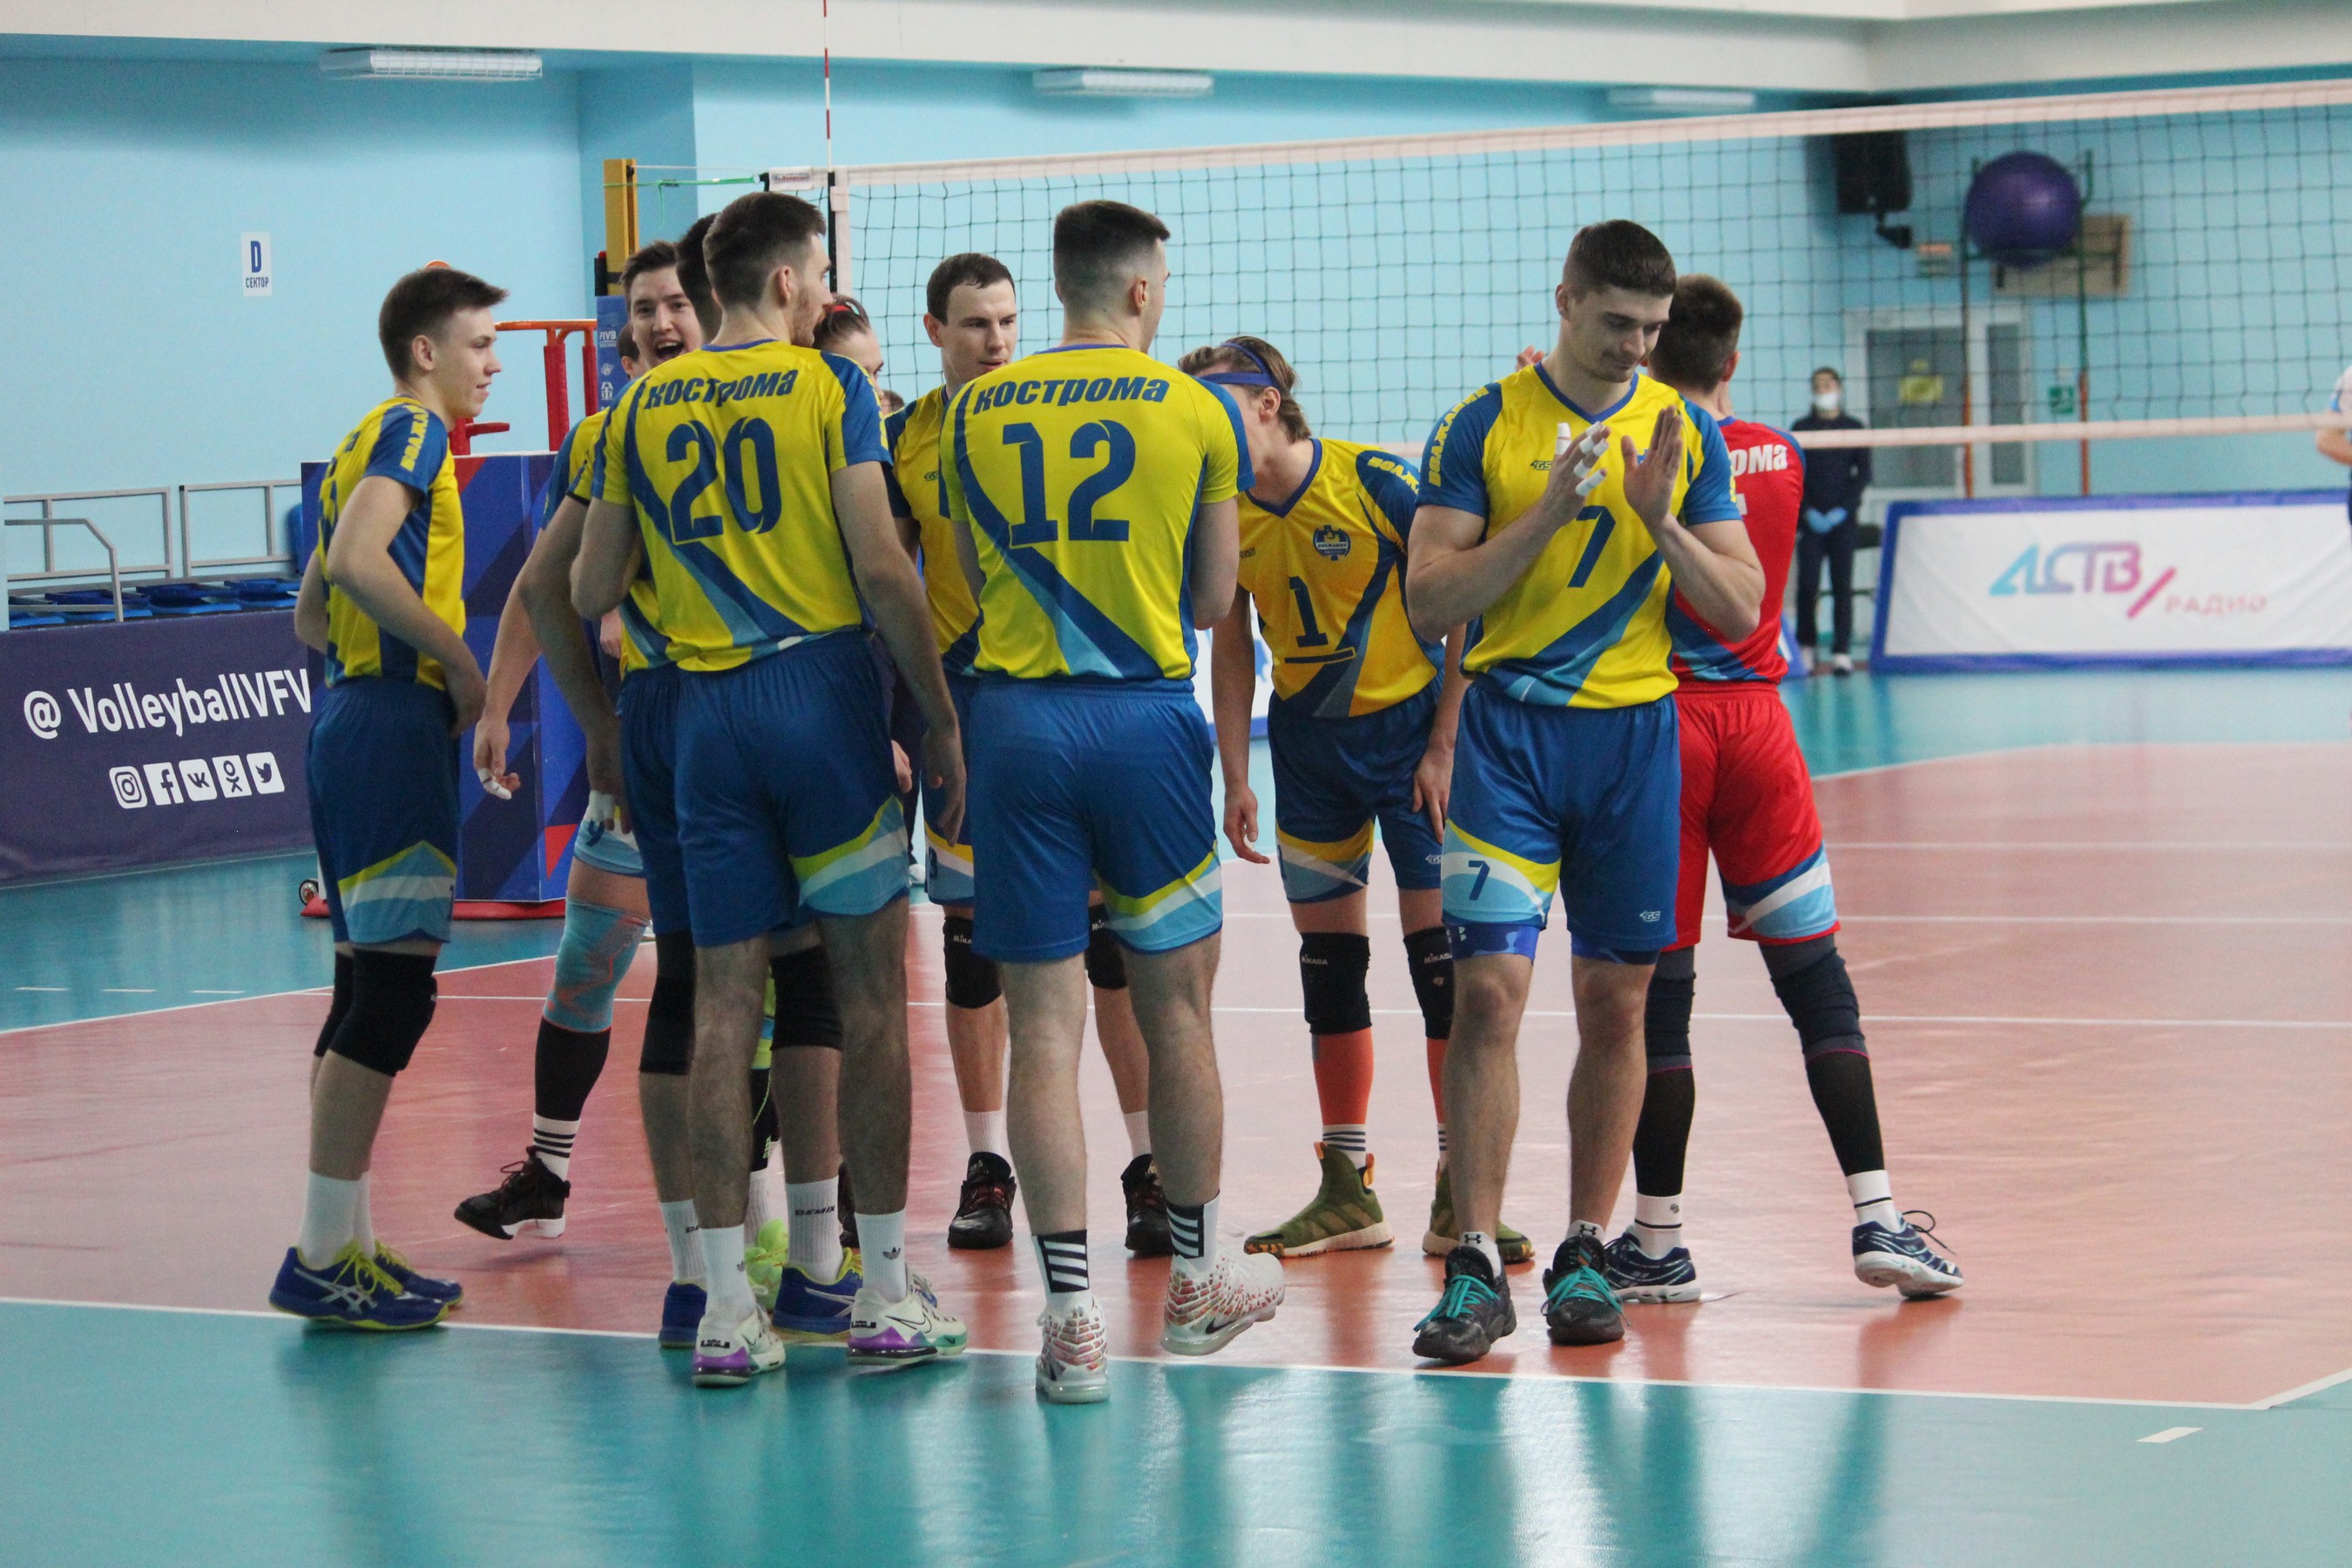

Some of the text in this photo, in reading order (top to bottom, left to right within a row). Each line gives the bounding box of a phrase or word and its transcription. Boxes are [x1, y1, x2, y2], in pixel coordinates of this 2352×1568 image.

[245, 276, 269, 288] СЕКТОР
[250, 240, 262, 273] D
[666, 416, 783, 543] 20
[1002, 419, 1136, 546] 12
[1367, 456, 1420, 495] ВОЛЖ
[1566, 504, 1617, 589] 7
[1288, 575, 1329, 648] 1
[24, 668, 312, 740] @ VolleyballVFV
[1468, 860, 1491, 901] 7
[794, 1205, 835, 1216] DEMIX
